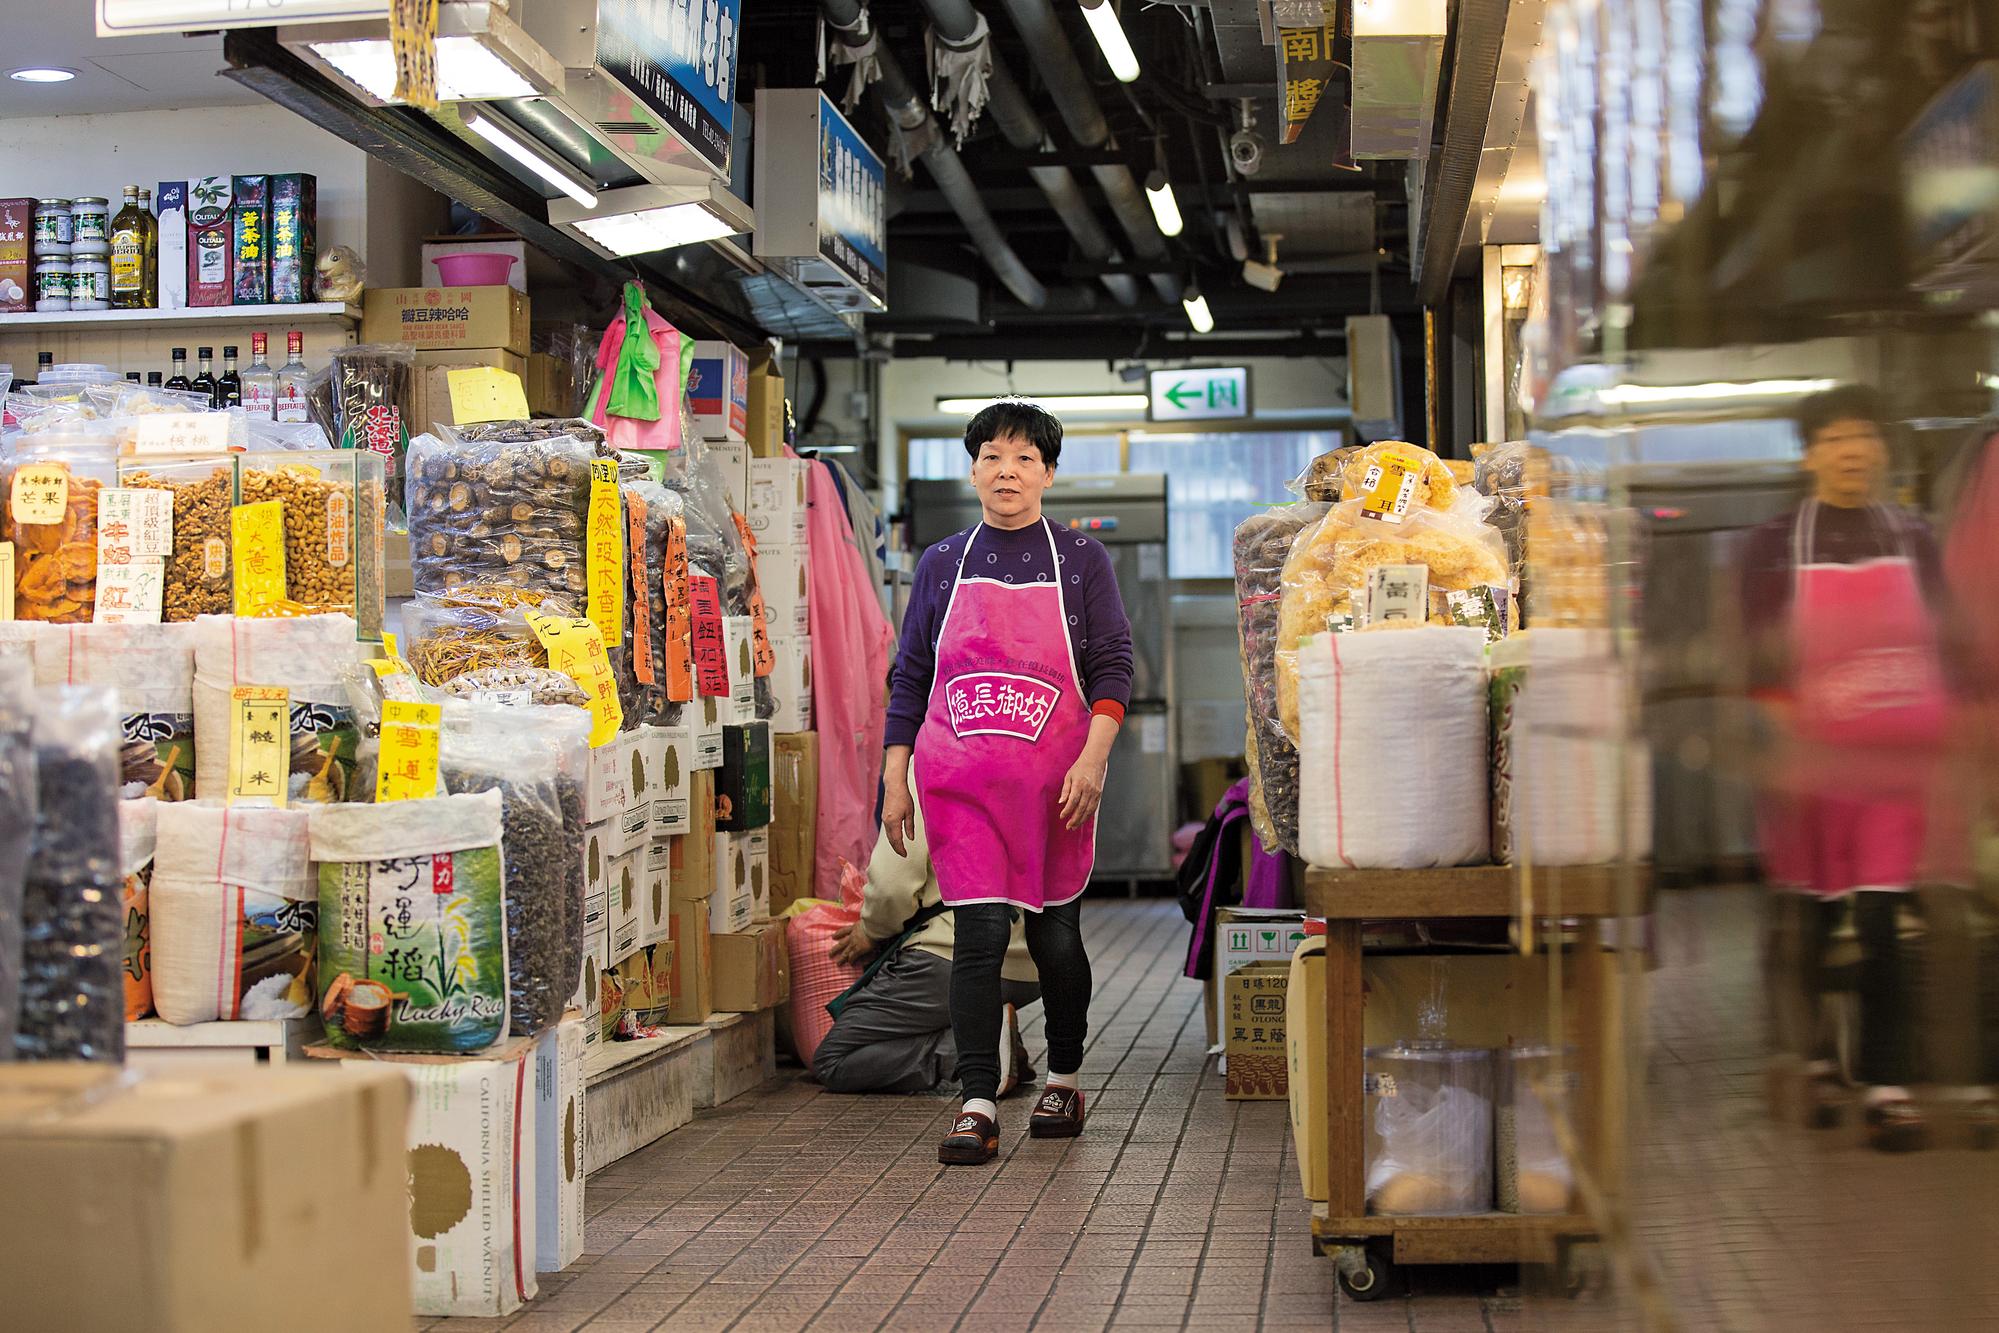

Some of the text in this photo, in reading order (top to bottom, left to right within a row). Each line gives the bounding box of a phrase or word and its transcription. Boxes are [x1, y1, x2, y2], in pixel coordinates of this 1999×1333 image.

[240, 211, 260, 259] 苦茶油
[275, 211, 294, 259] 苦茶油
[278, 402, 306, 412] BEEFEATER
[367, 405, 394, 456] 北海道
[21, 491, 60, 505] 芒果
[101, 521, 132, 565] 牛奶
[143, 493, 160, 553] 超頂級紅豆
[329, 498, 346, 562] 非油炸品
[208, 545, 223, 576] 烘焙
[594, 488, 617, 644] 天然段木香菇
[585, 638, 618, 724] 高山野生
[952, 683, 1048, 727] 億長御坊
[400, 1000, 466, 1023] Lucky
[480, 1076, 491, 1305] CALIFORNIA SHELLED WALNUTS
